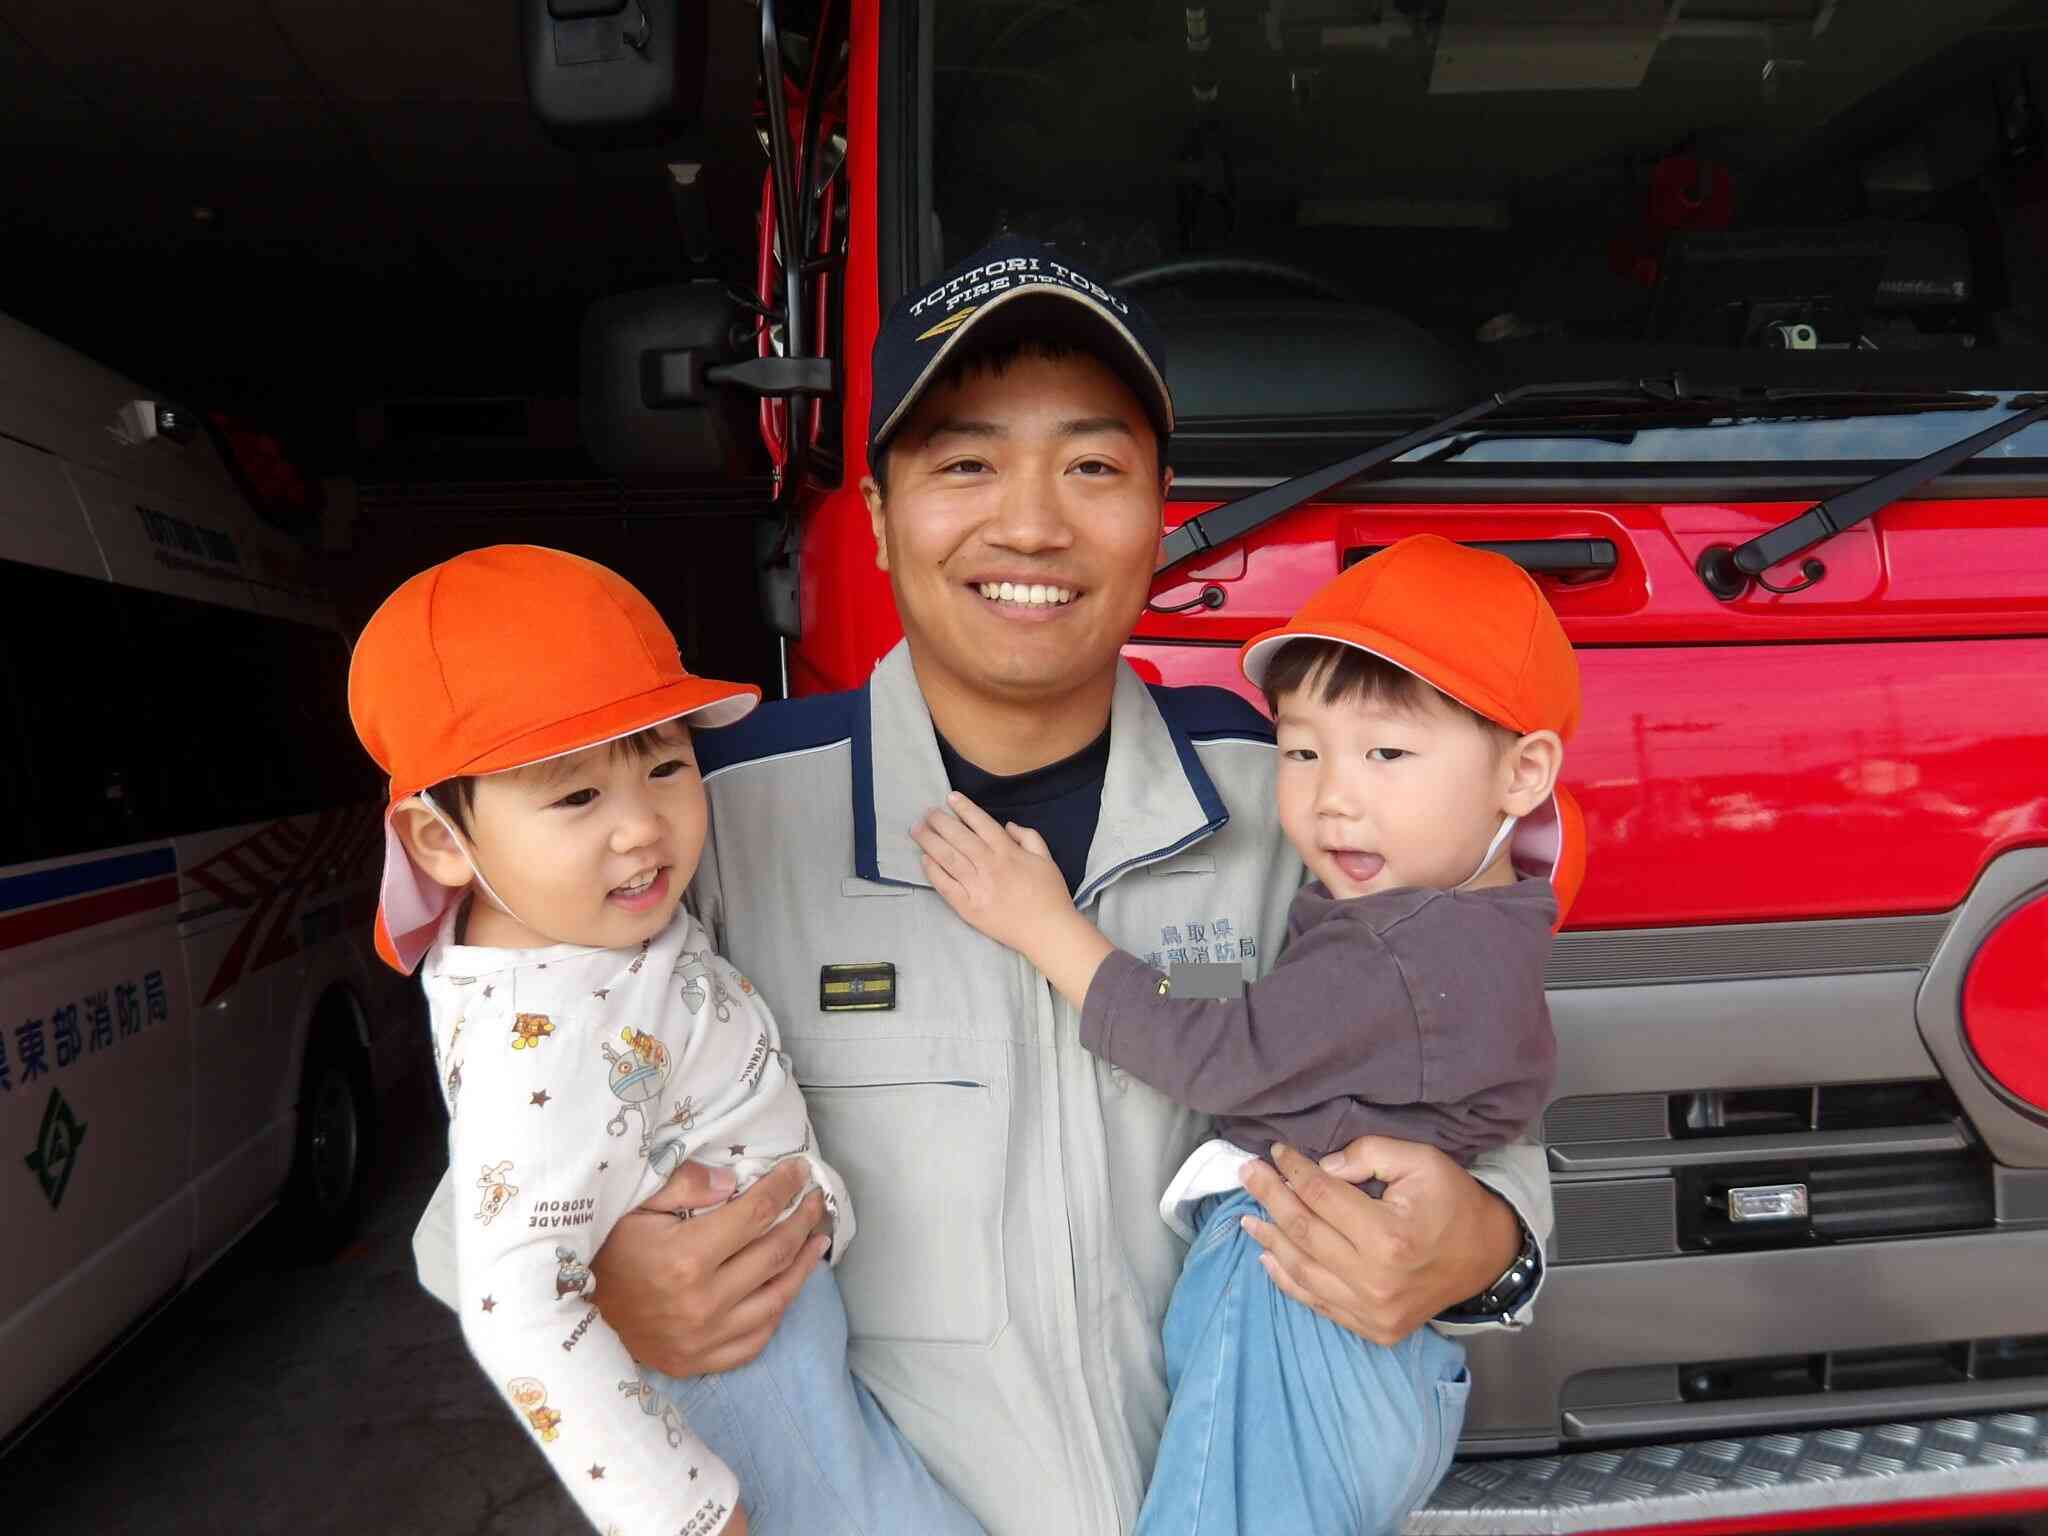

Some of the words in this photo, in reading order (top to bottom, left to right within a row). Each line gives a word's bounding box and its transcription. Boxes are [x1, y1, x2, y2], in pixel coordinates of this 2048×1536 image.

[909, 257, 1040, 317] TOTTORI
[1049, 262, 1129, 314] TOBU
[945, 276, 1010, 312] FIRE
[1161, 917, 1234, 946] 鳥取県
[528, 1210, 594, 1227] MINNADE
